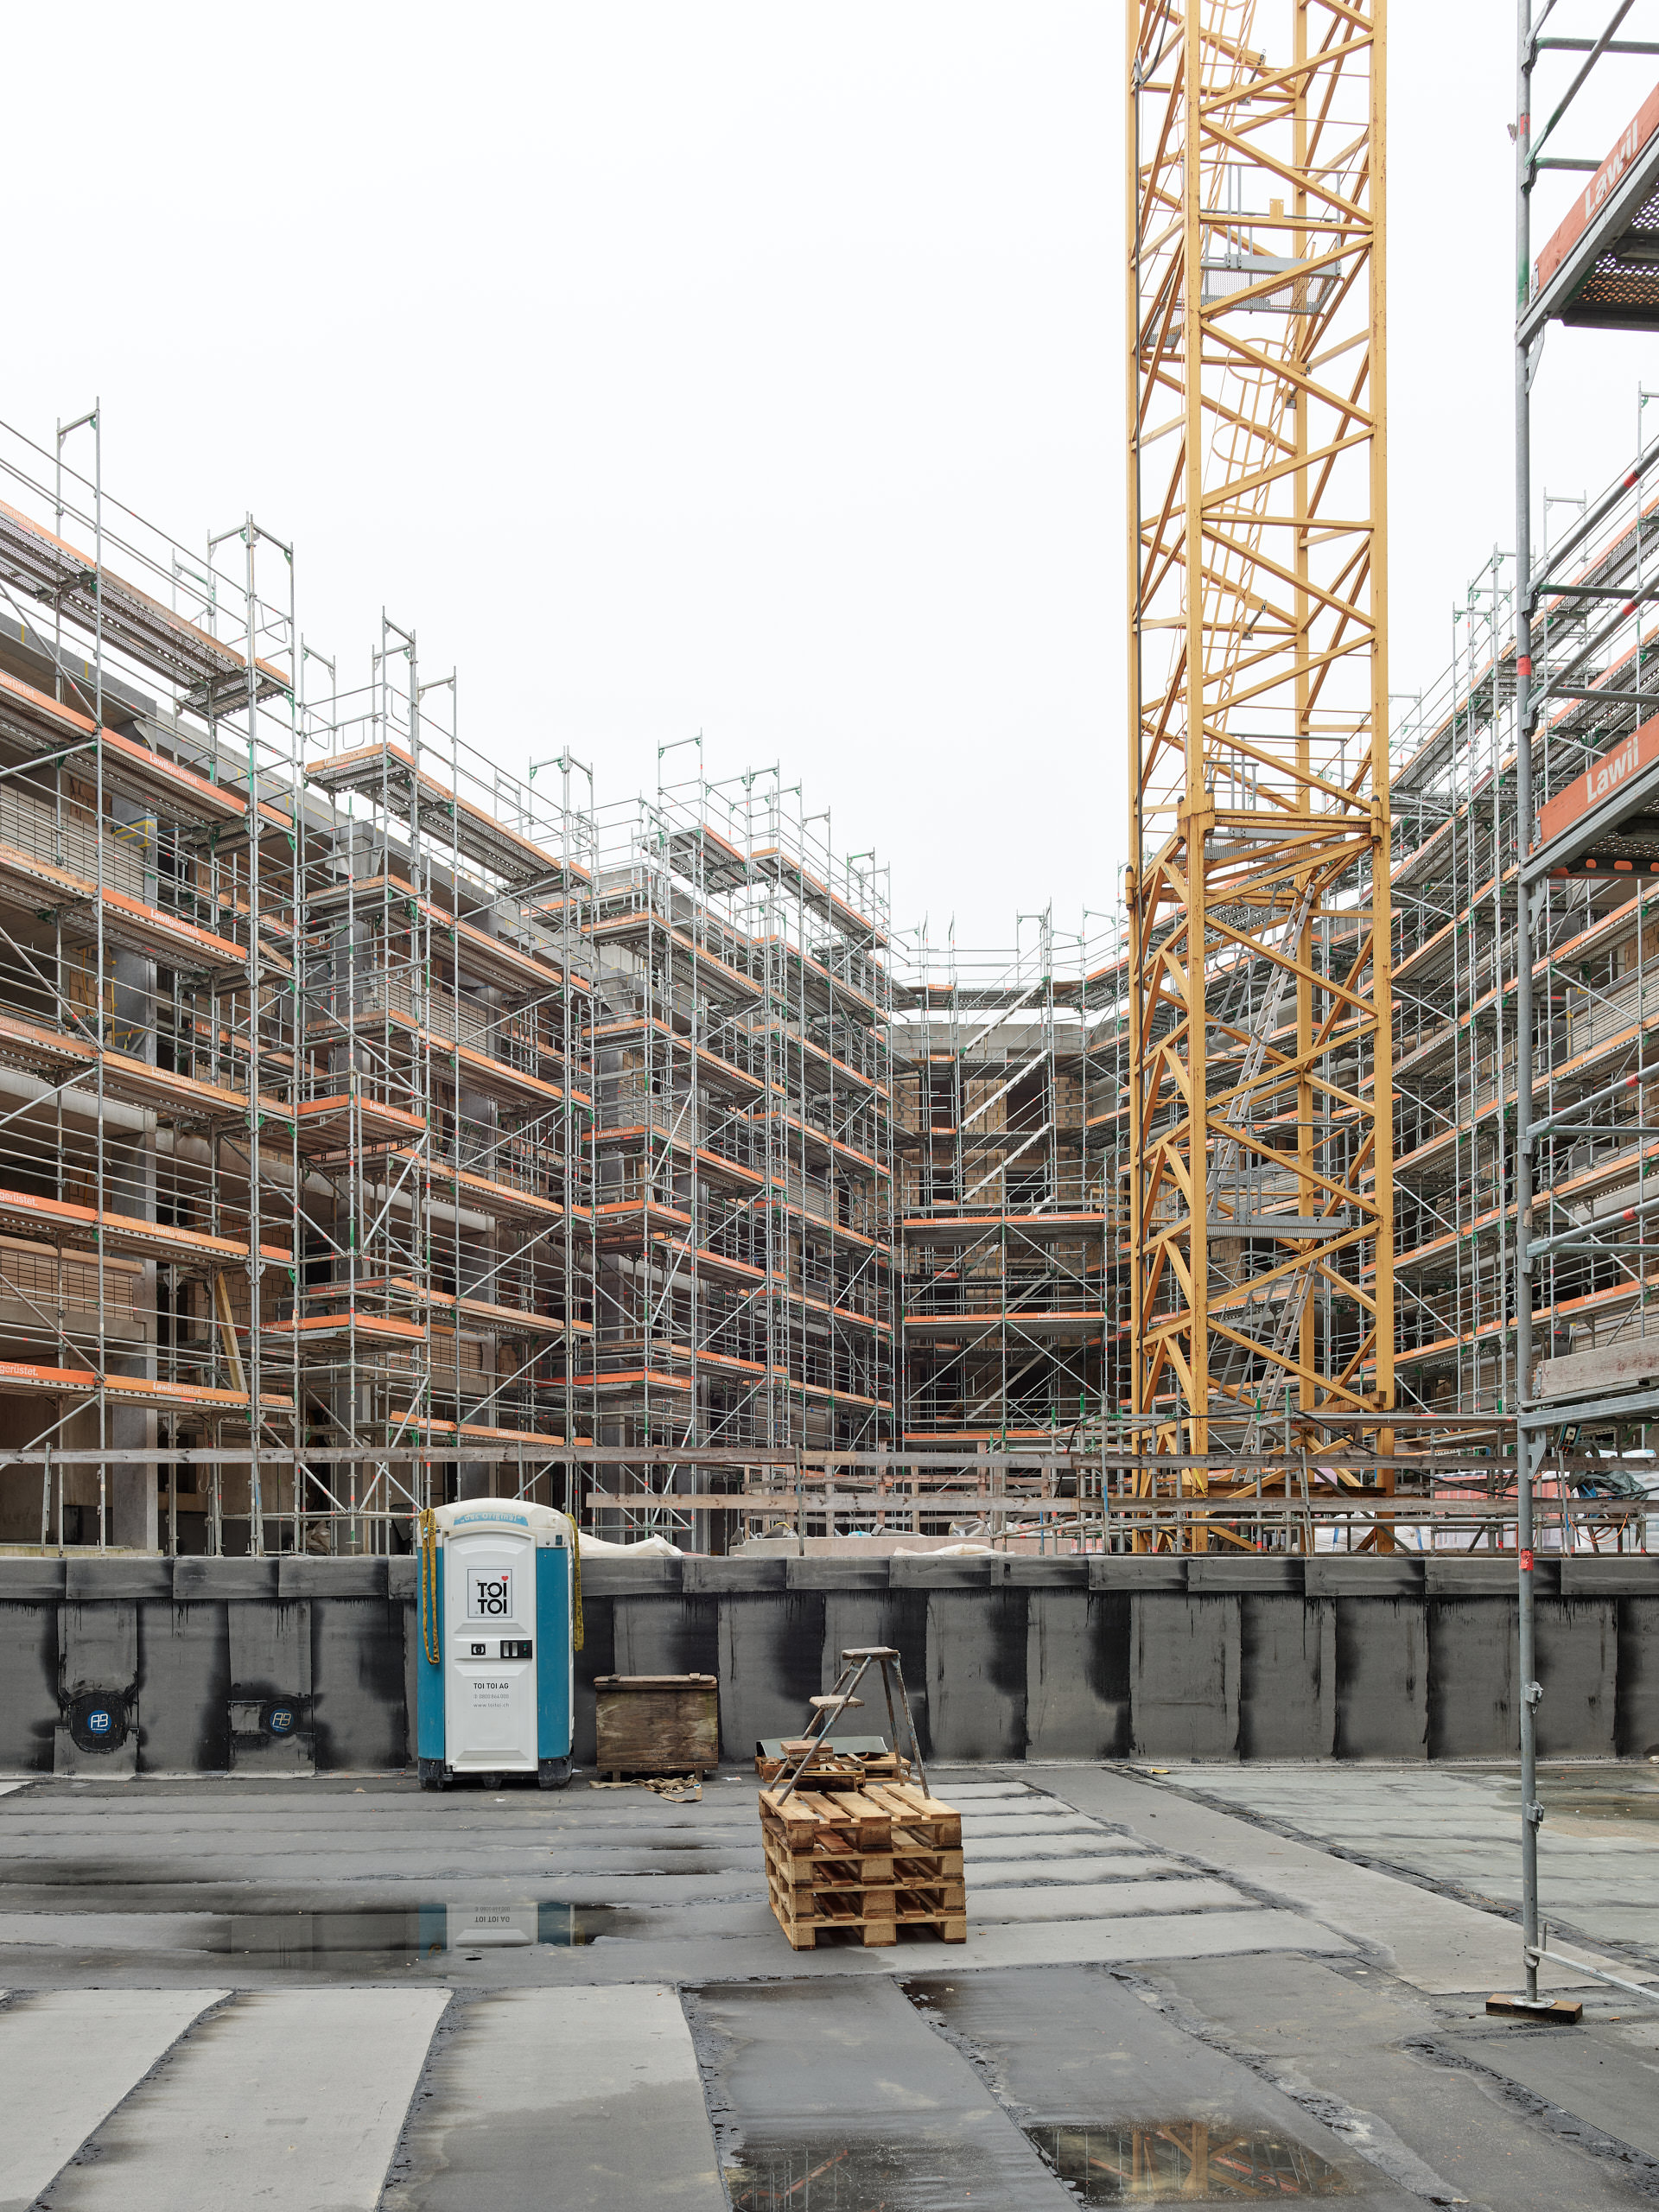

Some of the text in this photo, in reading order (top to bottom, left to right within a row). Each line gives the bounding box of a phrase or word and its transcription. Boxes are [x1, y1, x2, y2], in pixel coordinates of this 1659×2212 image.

[1585, 119, 1638, 219] Lawil
[149, 753, 200, 786] Lawilgerüstet.
[1586, 736, 1638, 804] Lawil
[150, 909, 201, 938] Lawilgerüstet.
[0, 1363, 38, 1376] gerüstet.
[477, 1582, 507, 1599] TOI
[477, 1599, 507, 1614] TOI
